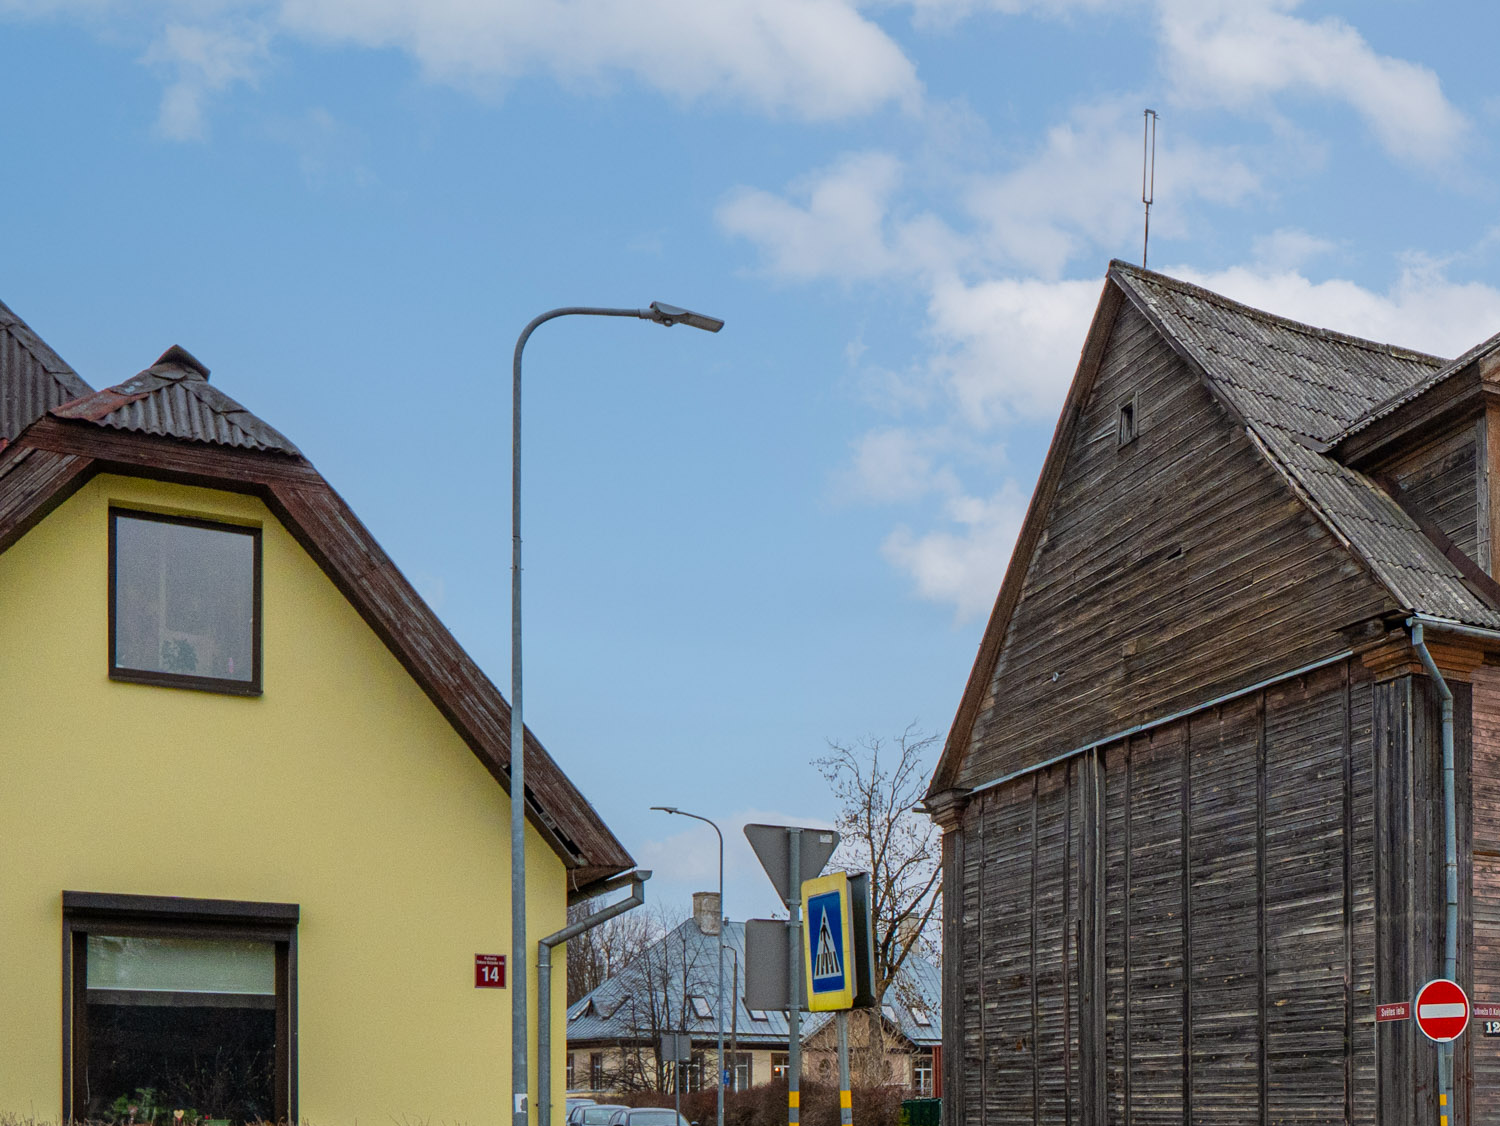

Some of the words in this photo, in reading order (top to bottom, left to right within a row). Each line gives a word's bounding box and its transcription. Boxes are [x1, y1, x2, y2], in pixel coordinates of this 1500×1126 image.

[481, 966, 499, 982] 14
[1396, 1006, 1405, 1016] iela
[1485, 1021, 1500, 1034] 12
